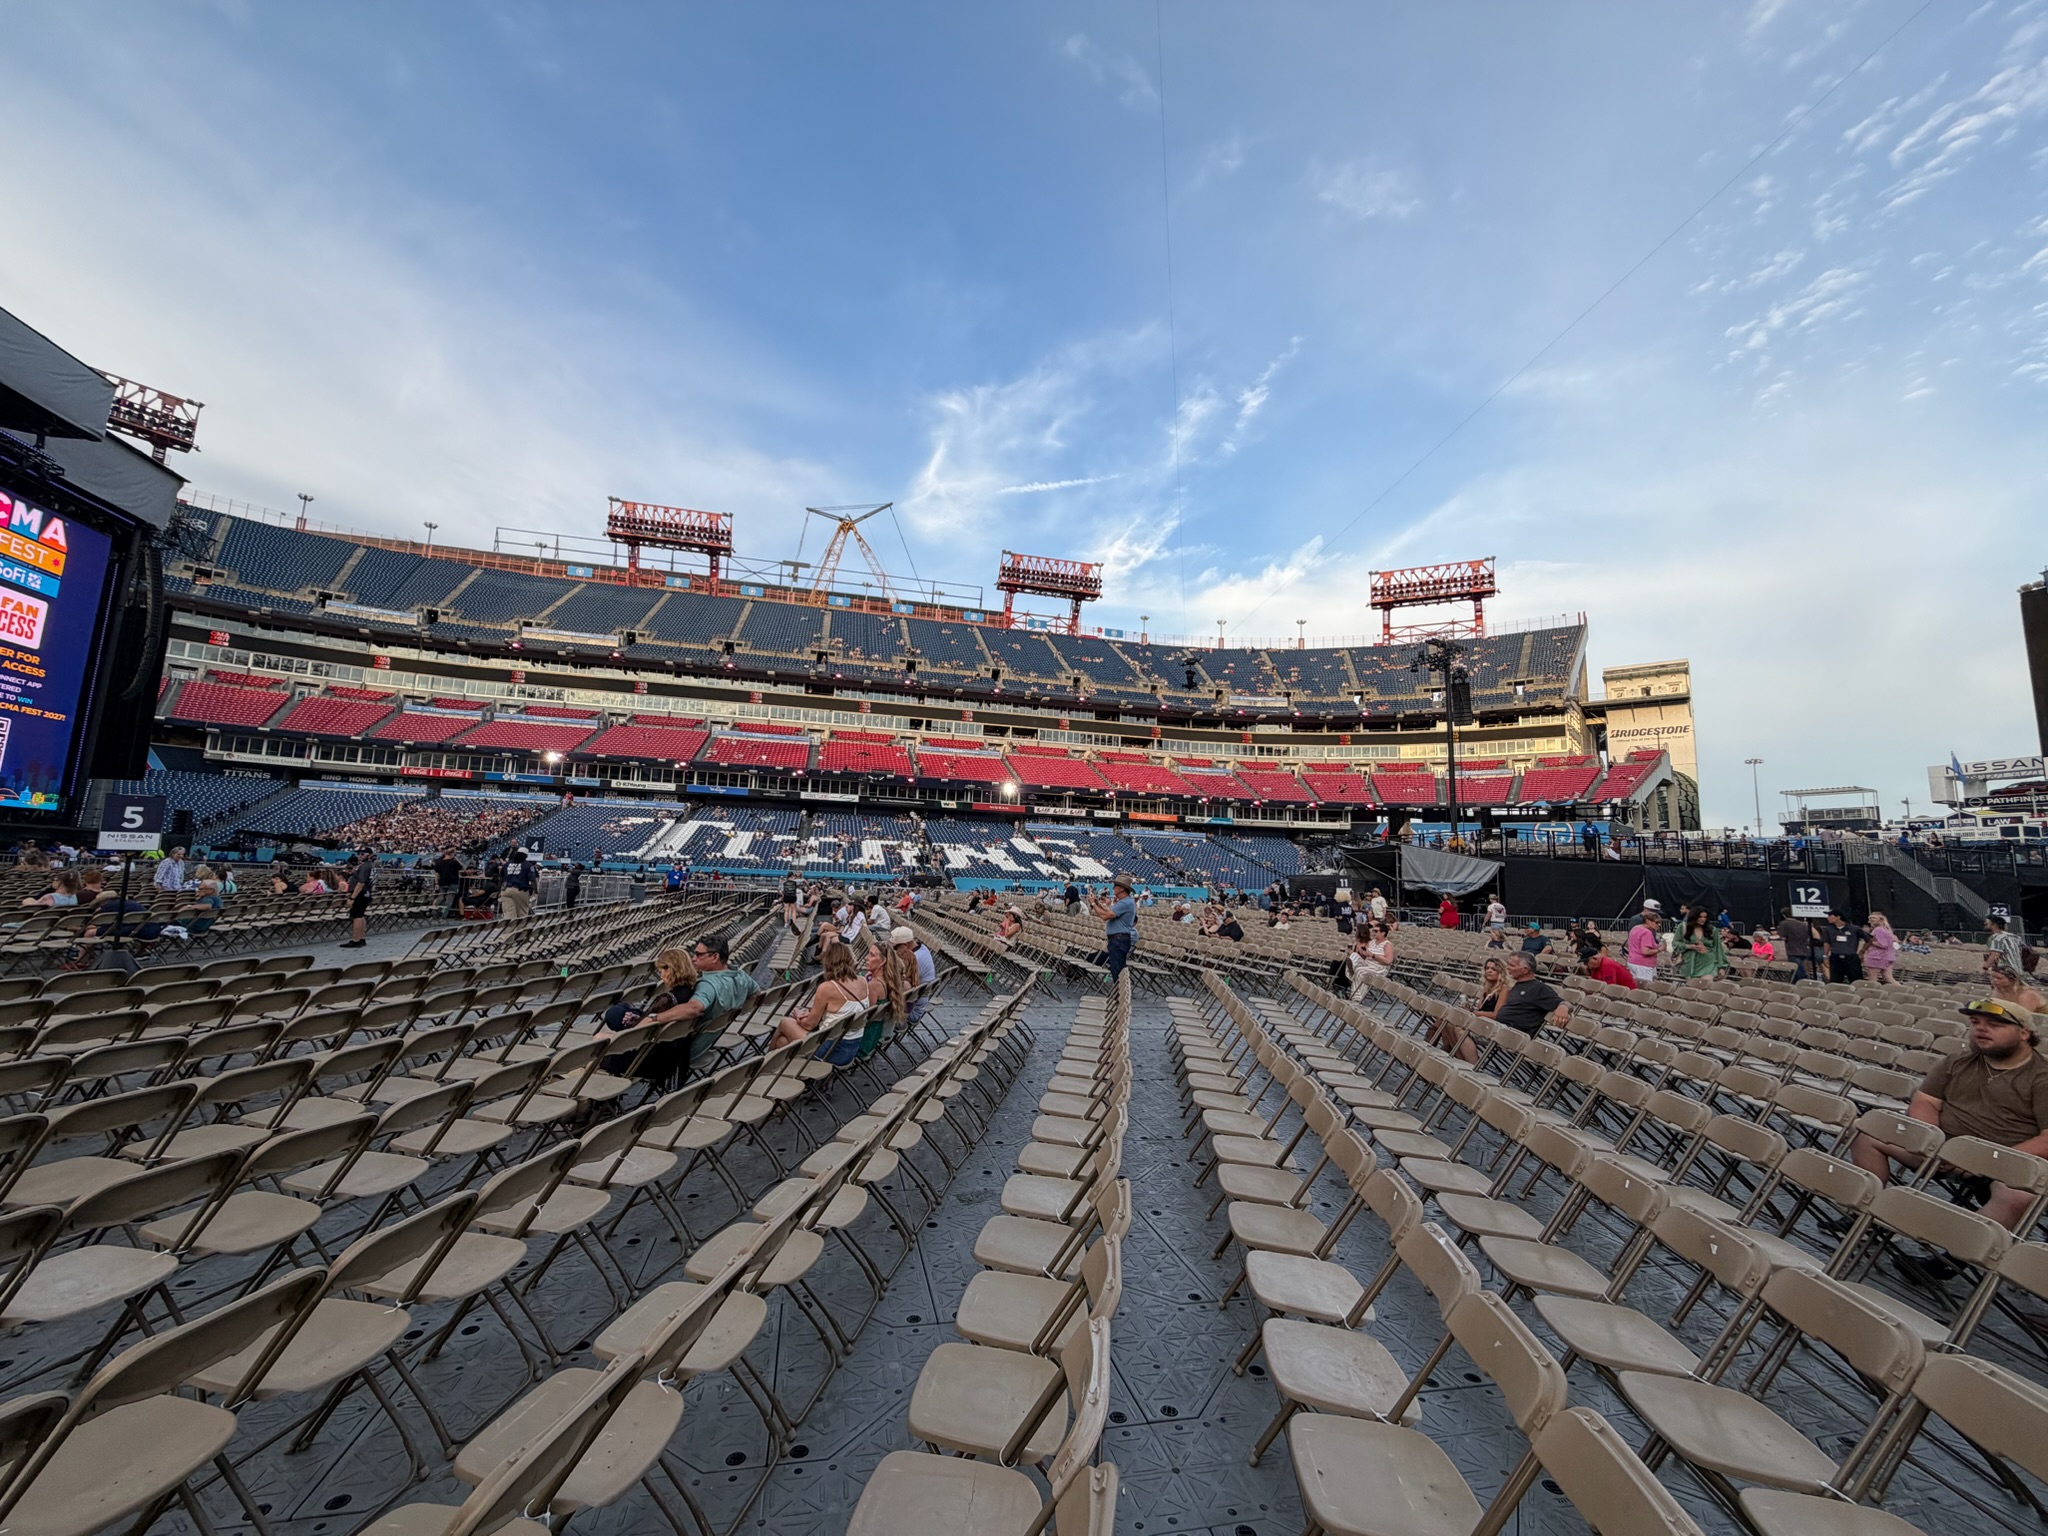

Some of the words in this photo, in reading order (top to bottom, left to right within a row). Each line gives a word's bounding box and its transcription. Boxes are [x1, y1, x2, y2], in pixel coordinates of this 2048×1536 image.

[0, 532, 49, 564] FEST
[1, 596, 39, 619] FAN
[16, 651, 40, 665] FOR
[2, 660, 46, 678] ACCESS
[27, 681, 43, 689] APP
[5, 693, 17, 701] TO
[17, 696, 33, 705] WIN
[0, 702, 19, 712] CMA
[21, 706, 43, 717] FEST
[43, 711, 66, 721] 2027!
[1609, 725, 1691, 739] BRIDGESTONE
[1946, 758, 2044, 775] NISSAN
[223, 769, 271, 779] TITANS
[1986, 795, 2048, 805] PATHFINDE
[121, 806, 144, 829] 5
[1987, 818, 2012, 826] LAW
[530, 841, 539, 852] 4
[564, 850, 569, 858] 3
[1340, 879, 1348, 887] 11
[1796, 887, 1822, 903] 12
[1992, 906, 2008, 916] 22
